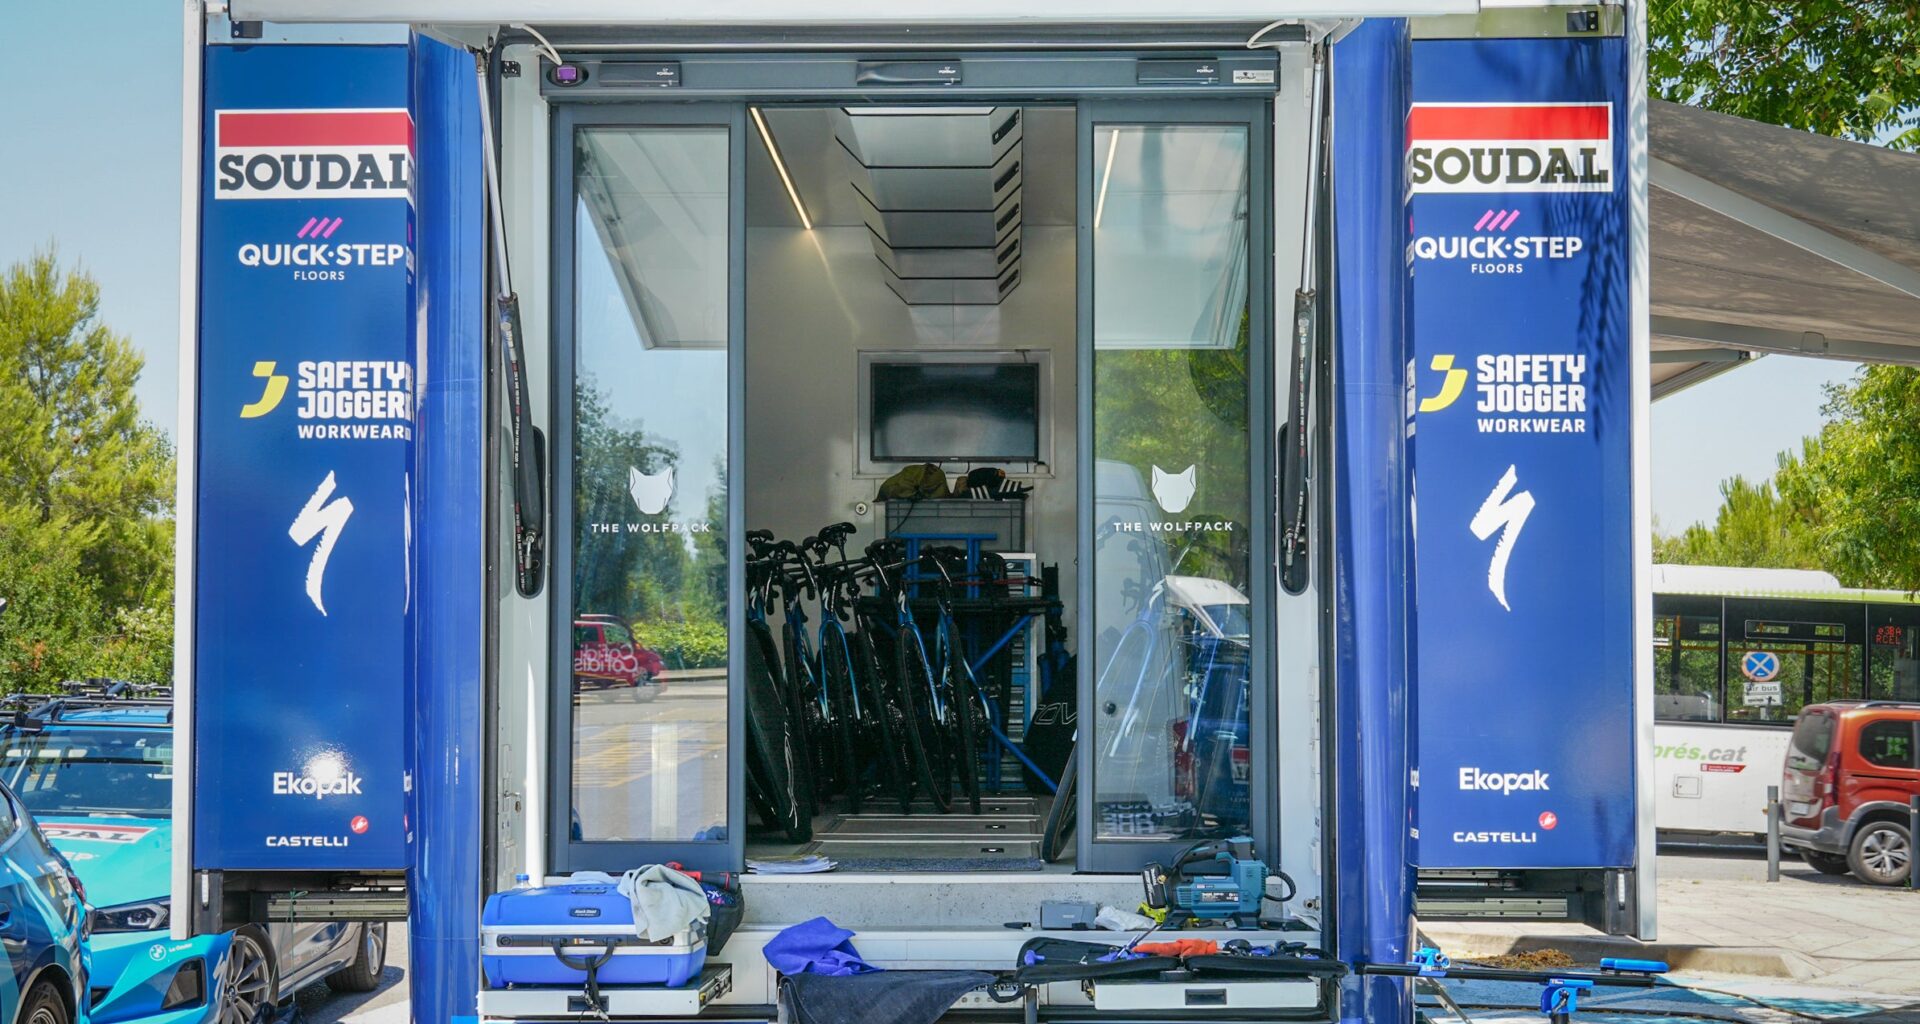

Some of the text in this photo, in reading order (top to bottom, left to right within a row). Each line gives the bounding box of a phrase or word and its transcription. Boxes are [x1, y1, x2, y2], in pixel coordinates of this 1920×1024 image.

[1412, 147, 1609, 185] SOUDAL
[294, 270, 345, 281] FLOORS
[1471, 263, 1523, 274] FLOORS
[297, 361, 406, 389] SAFETY
[1477, 354, 1586, 383] SAFETY
[297, 390, 405, 419] JOGGER
[1477, 384, 1586, 412] JOGGER
[298, 425, 404, 439] WORKWEAR
[1477, 418, 1586, 433] WORKWEAR
[591, 523, 711, 533] THE WOLFPACK
[1113, 521, 1233, 532] THE WOLFPACK
[272, 772, 362, 800] Ekopak
[1459, 767, 1550, 796] Ekopak
[265, 836, 349, 847] CASTELLI
[1453, 832, 1537, 843] CASTELLI
